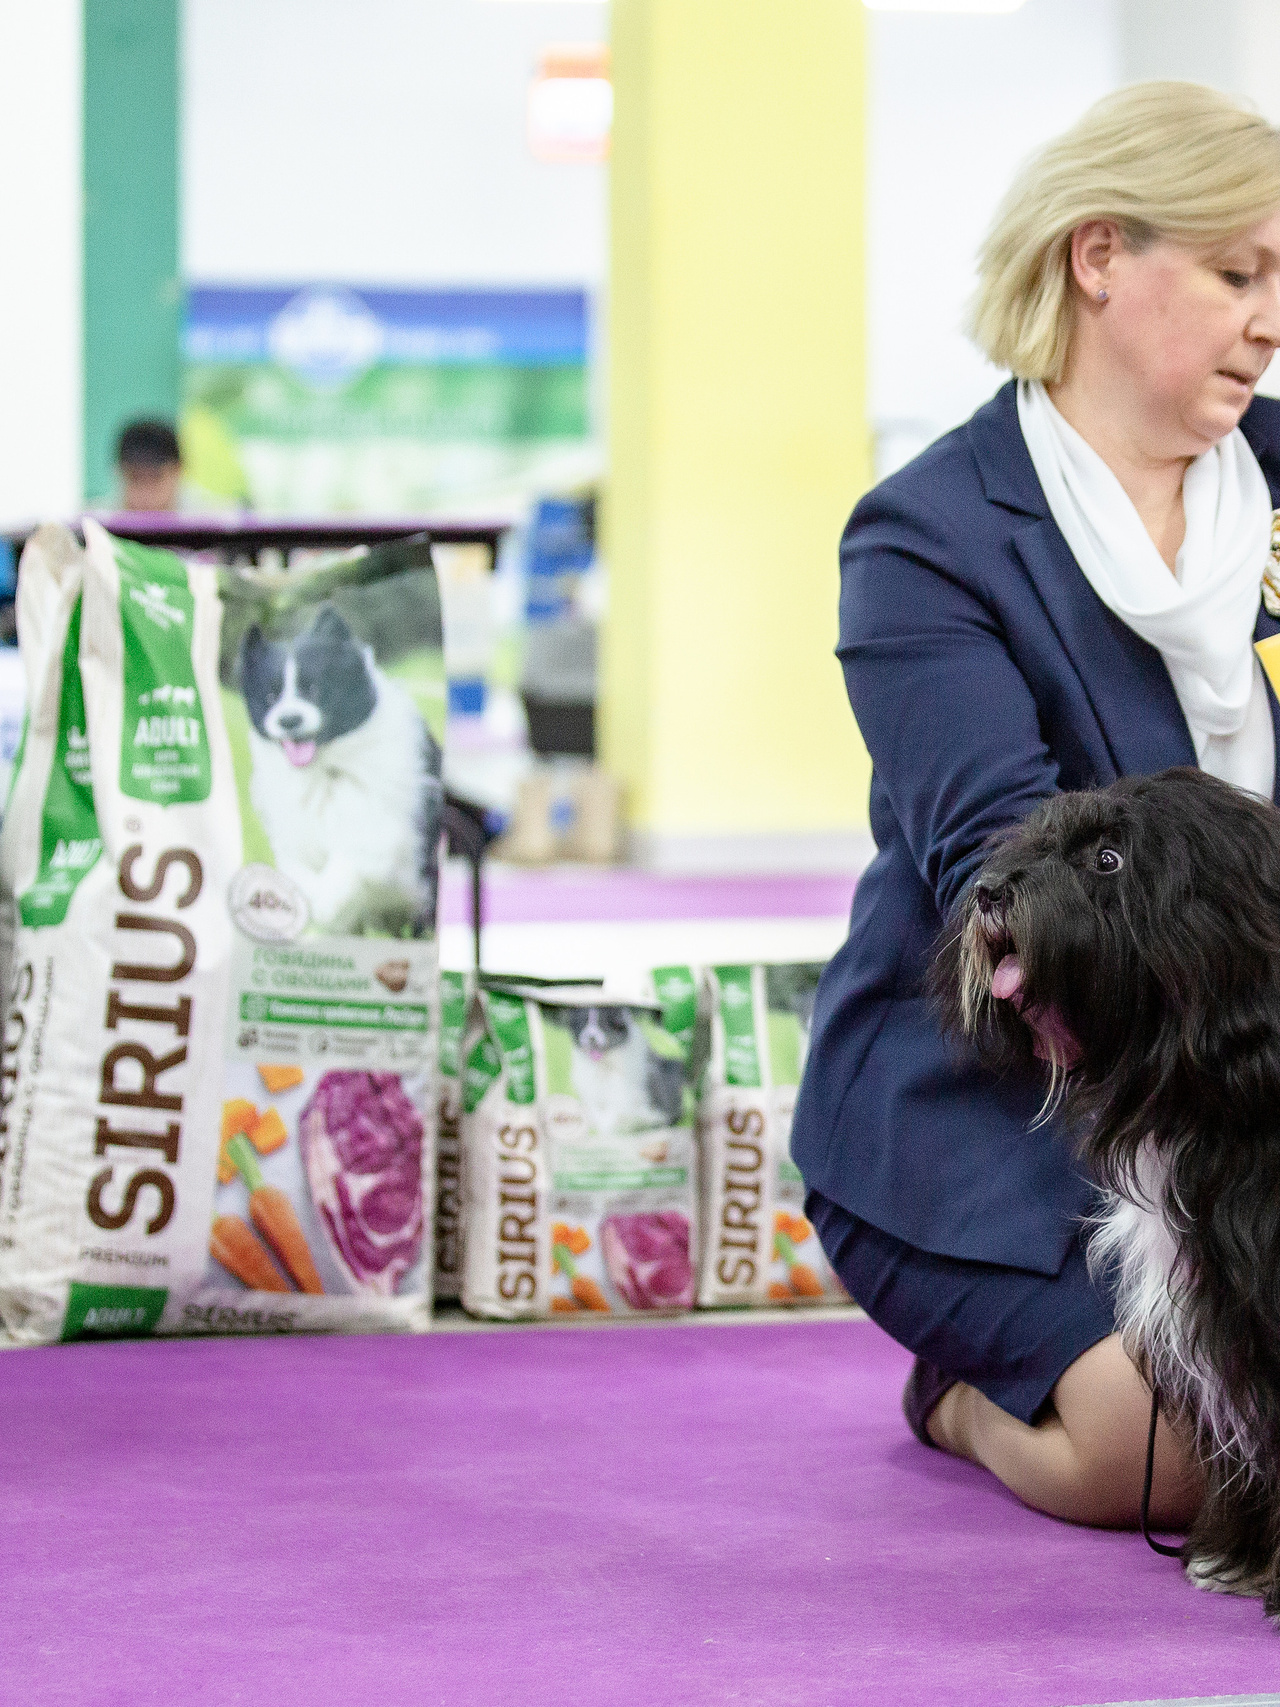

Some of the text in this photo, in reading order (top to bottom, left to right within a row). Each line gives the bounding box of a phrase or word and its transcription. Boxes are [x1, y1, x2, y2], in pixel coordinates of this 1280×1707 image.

[134, 715, 200, 747] ADULT
[86, 844, 204, 1236] SIRIUS
[79, 1247, 170, 1268] PREMIUM
[498, 1122, 539, 1301] SIRIUS
[716, 1106, 766, 1288] SIRIUS
